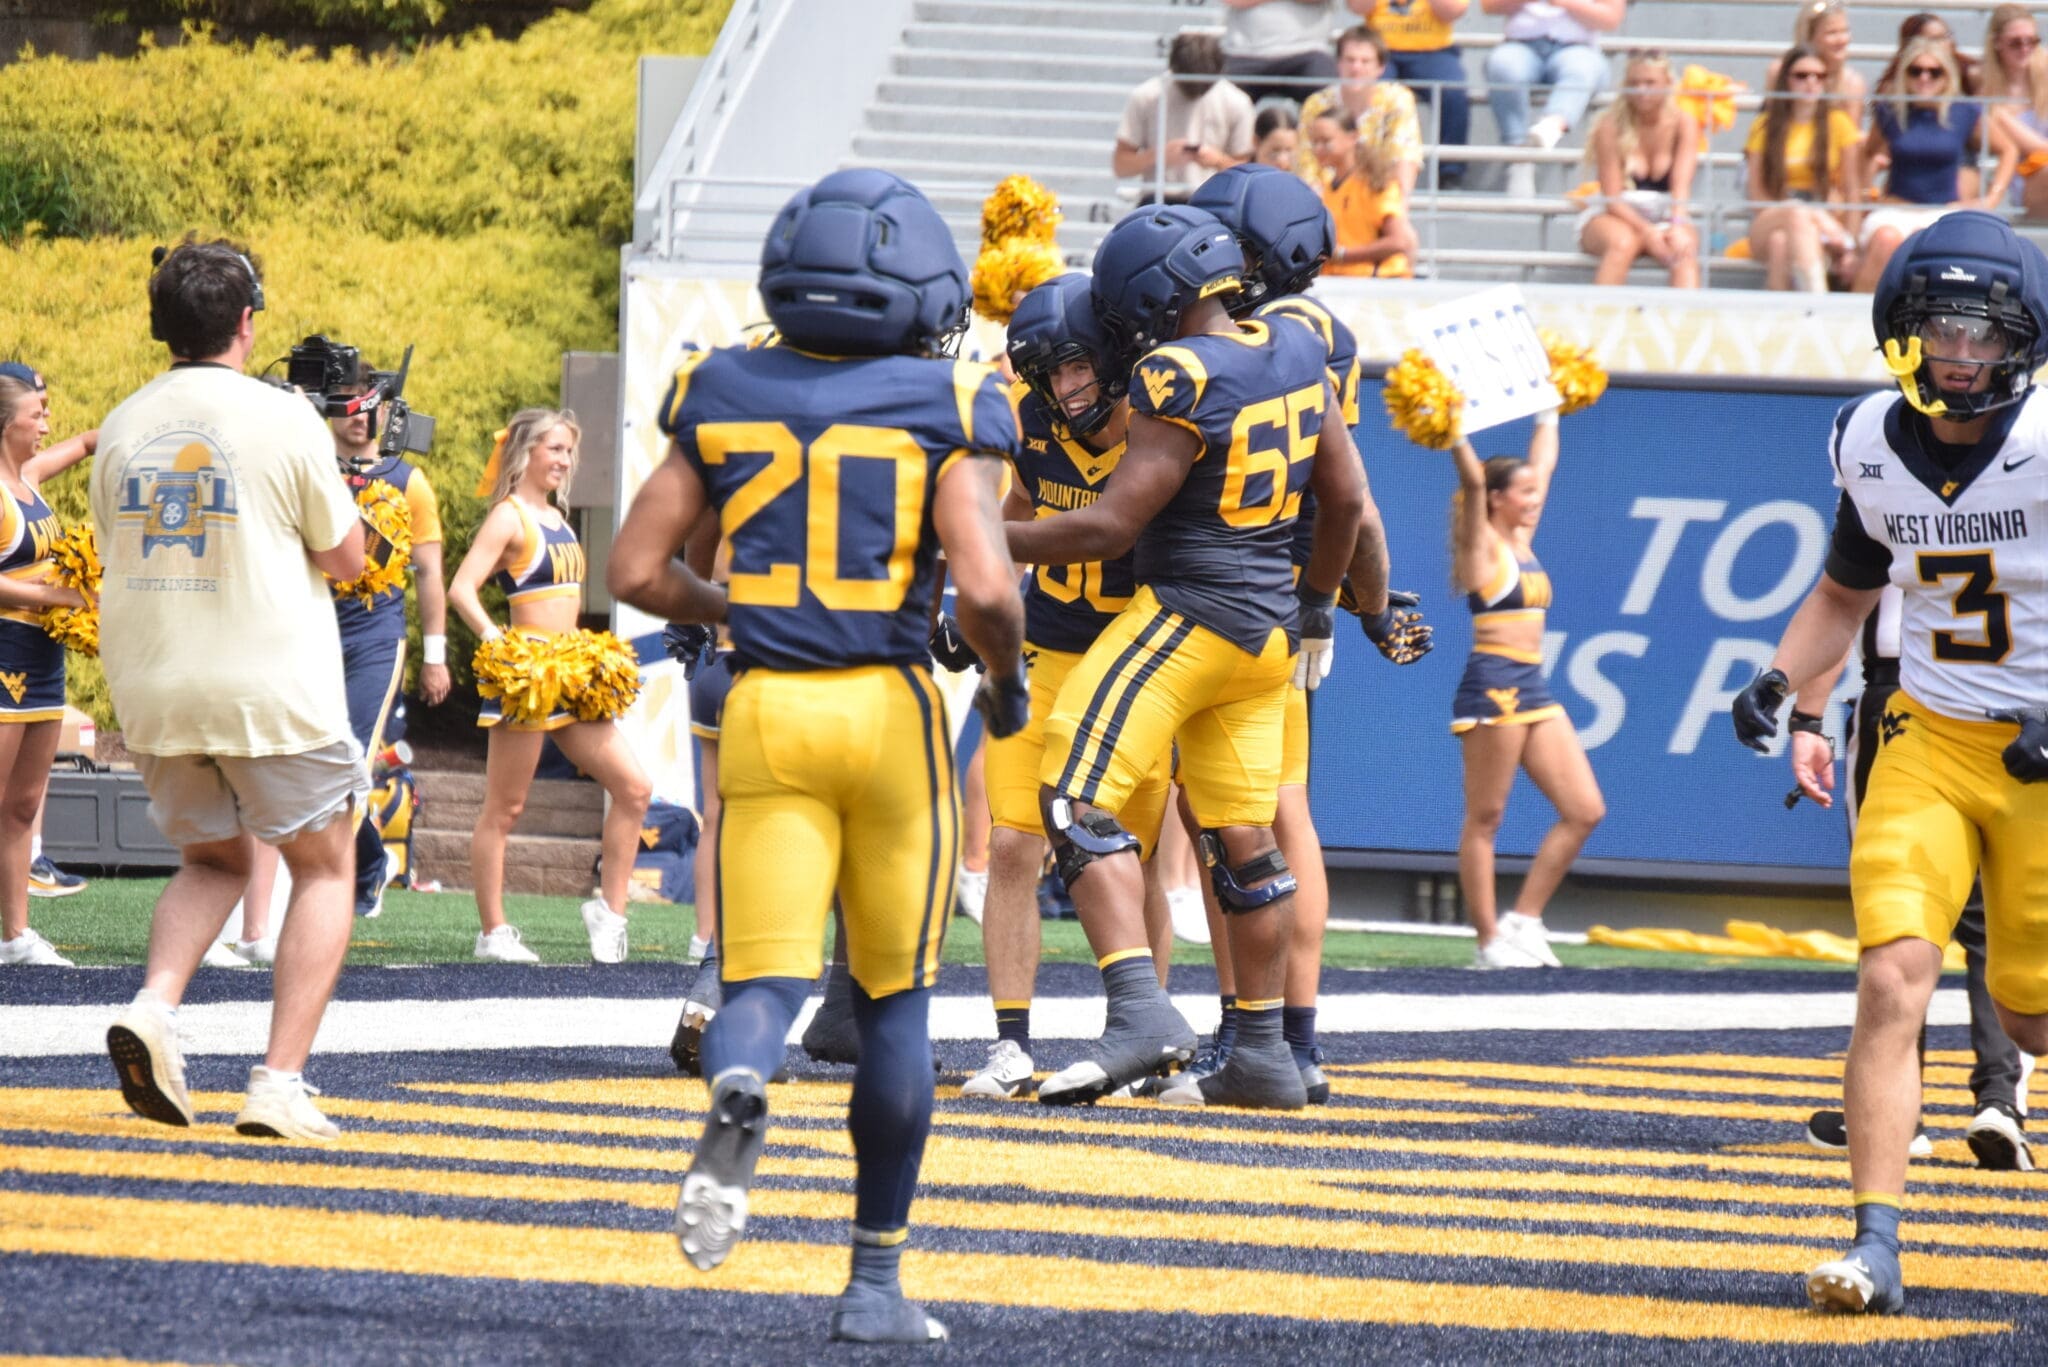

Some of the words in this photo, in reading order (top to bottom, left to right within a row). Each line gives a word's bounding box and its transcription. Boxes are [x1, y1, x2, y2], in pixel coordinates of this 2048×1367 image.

[696, 421, 927, 612] 20
[1217, 382, 1326, 528] 65
[1619, 497, 1828, 622] TO
[1883, 513, 1929, 545] WEST
[1934, 509, 2028, 545] VIRGINIA
[1914, 548, 2015, 666] 3
